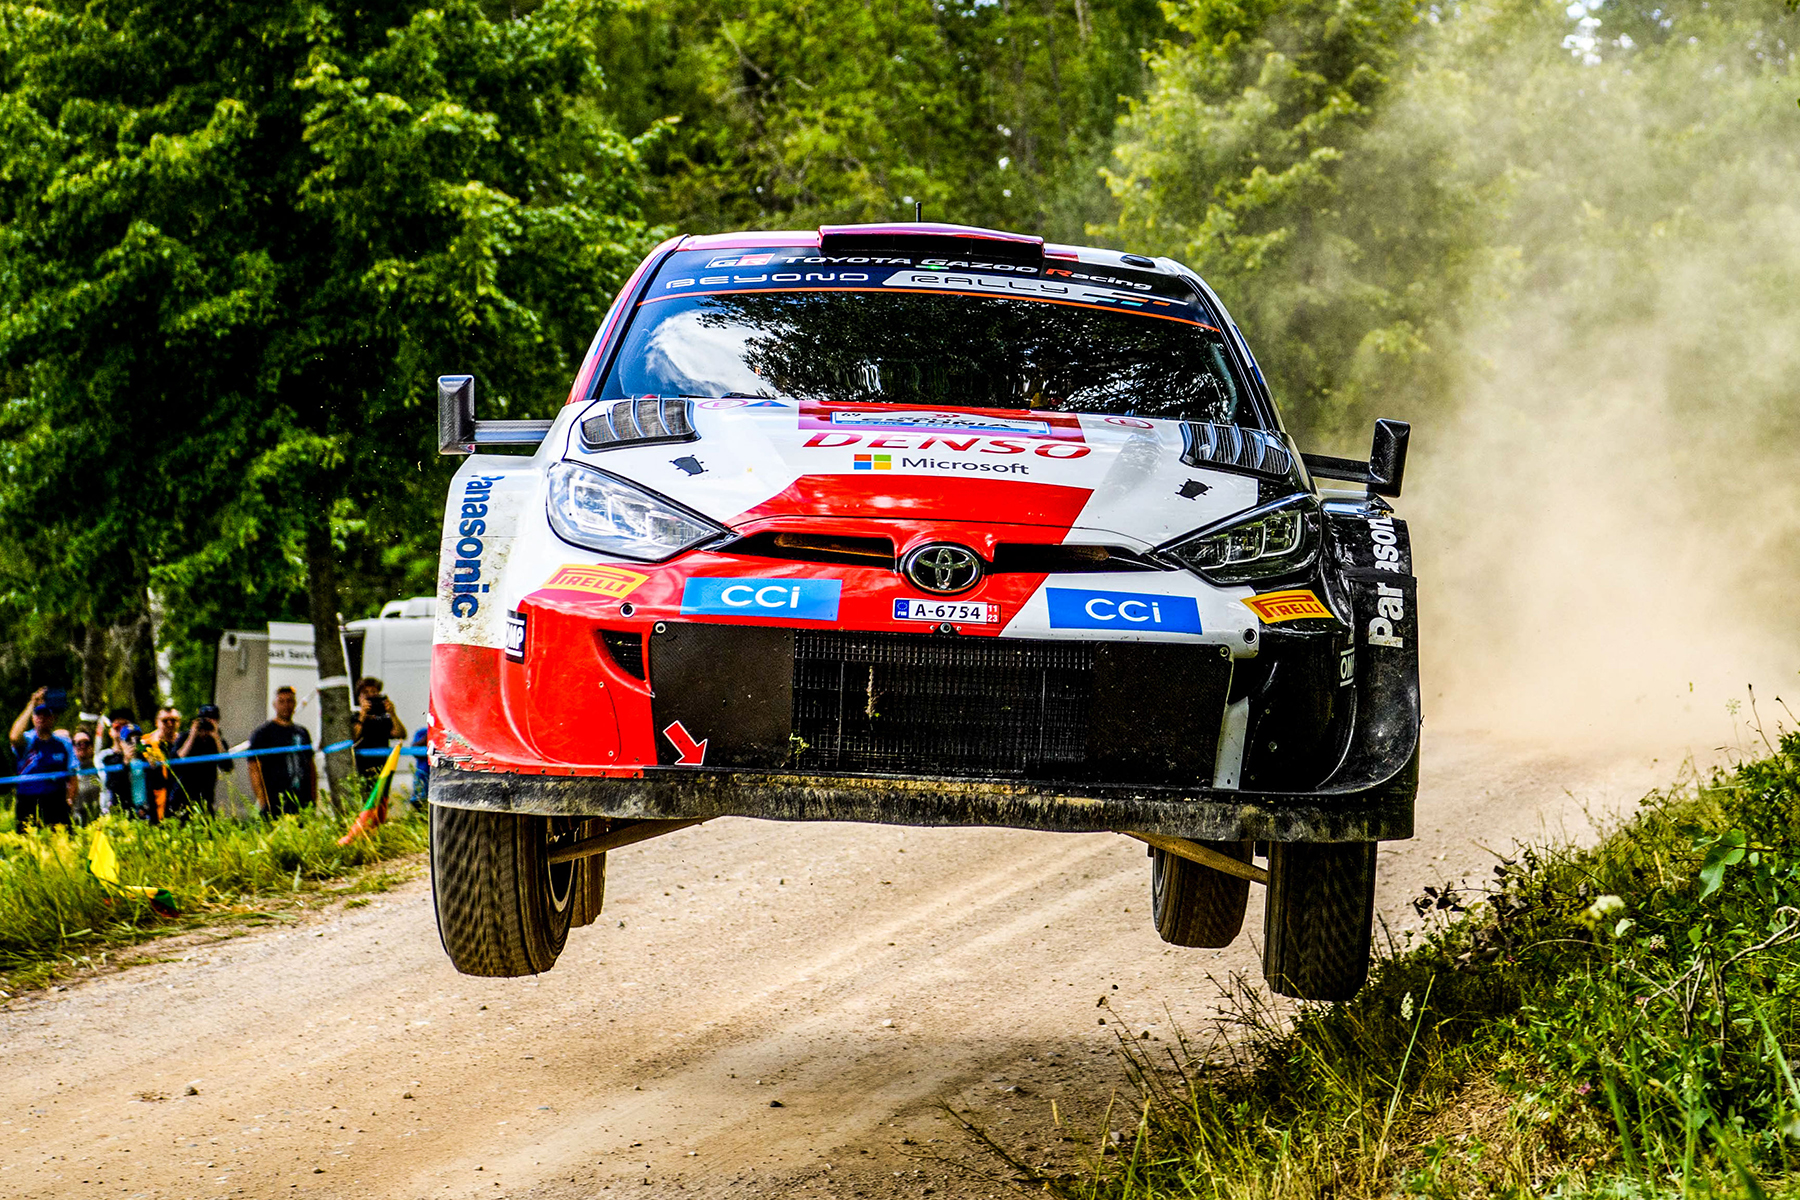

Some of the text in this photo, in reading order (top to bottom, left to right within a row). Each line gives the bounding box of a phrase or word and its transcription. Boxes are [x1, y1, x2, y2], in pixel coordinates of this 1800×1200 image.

[666, 273, 1069, 294] BEYOND RALLY
[711, 256, 1153, 290] GR TOYOTA GAZOO Racing
[803, 432, 1092, 460] DENSO
[902, 457, 1029, 475] Microsoft
[549, 568, 636, 593] PIRELLI
[915, 604, 980, 619] A-6754
[1251, 595, 1323, 618] PIRELLI
